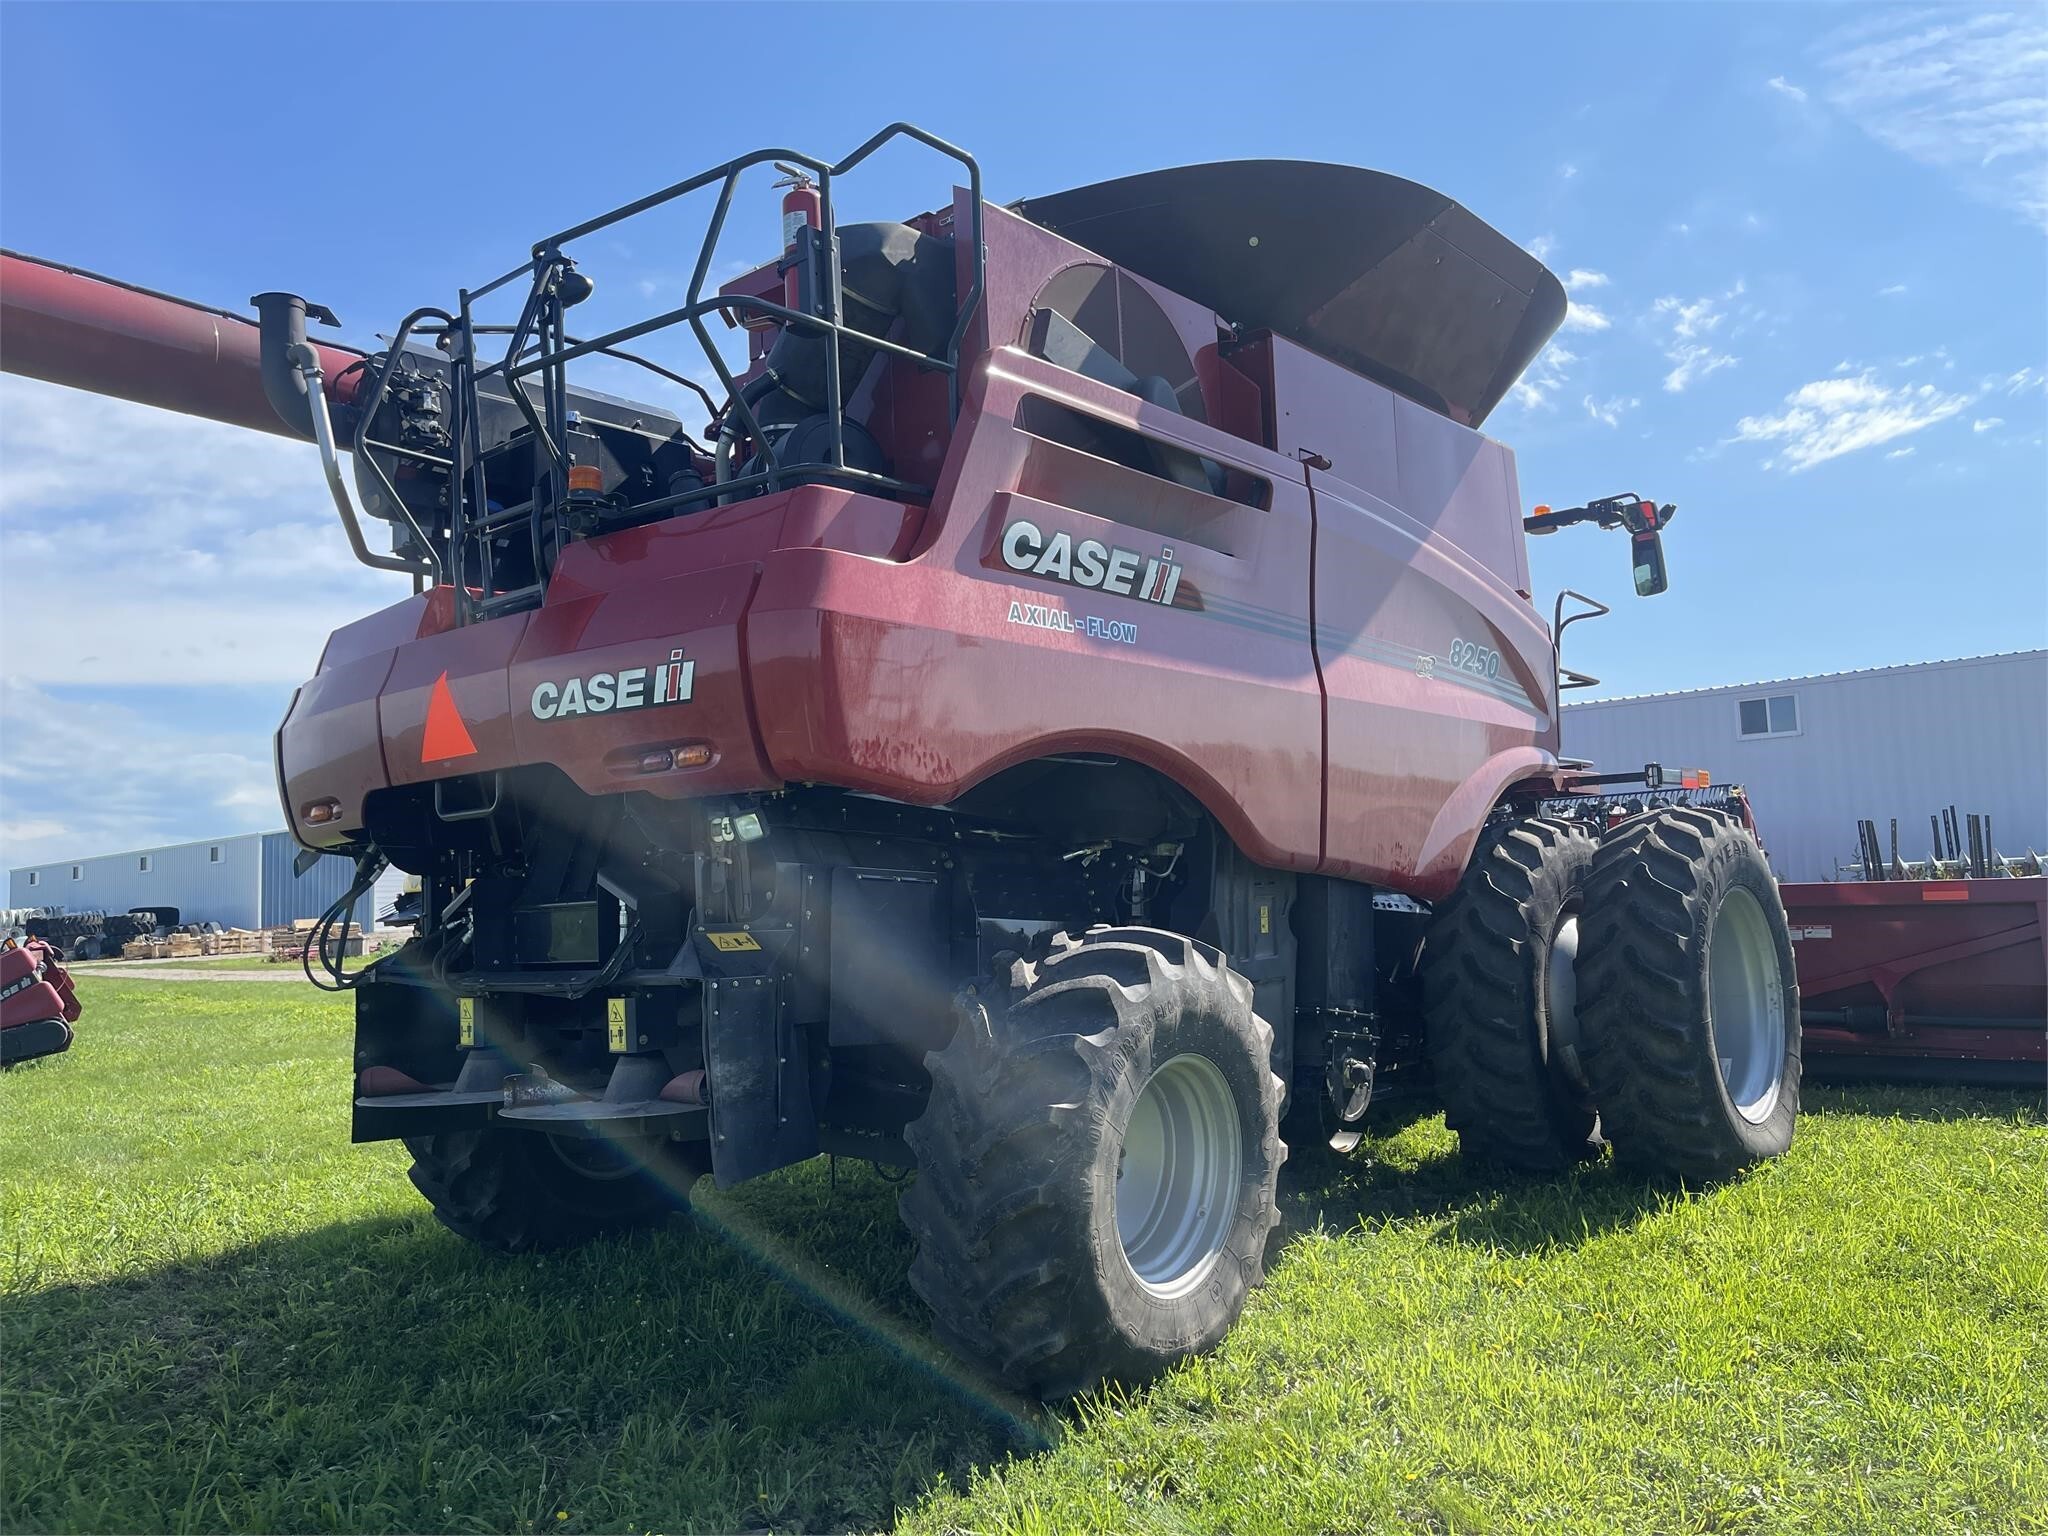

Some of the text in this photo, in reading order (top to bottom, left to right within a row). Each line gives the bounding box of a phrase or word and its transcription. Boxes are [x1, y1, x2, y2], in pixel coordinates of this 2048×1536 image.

[1002, 521, 1140, 595] CASE
[1449, 637, 1501, 681] 8250
[531, 667, 647, 720] CASE
